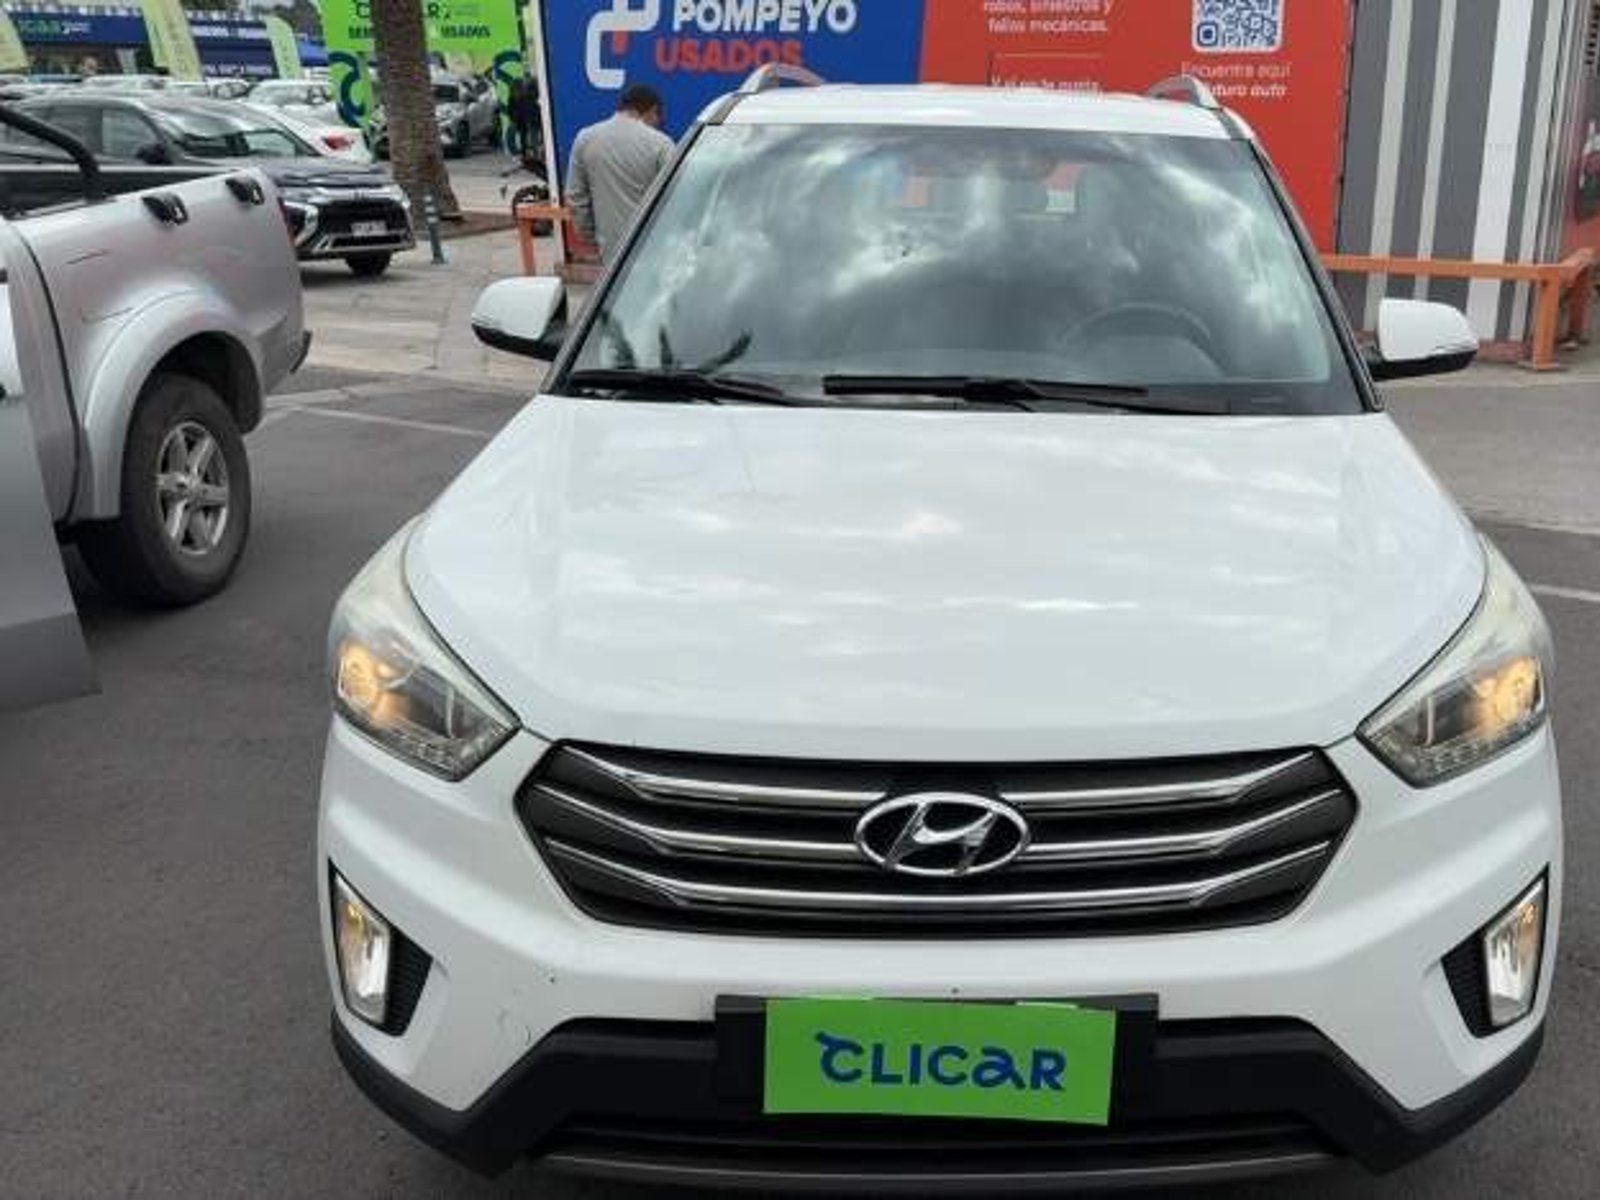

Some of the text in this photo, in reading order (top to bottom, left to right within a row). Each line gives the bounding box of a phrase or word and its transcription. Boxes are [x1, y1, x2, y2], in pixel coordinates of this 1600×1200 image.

[673, 0, 857, 32] POMPEYO
[655, 38, 803, 72] USADOS
[814, 1032, 1066, 1091] CLICAR
